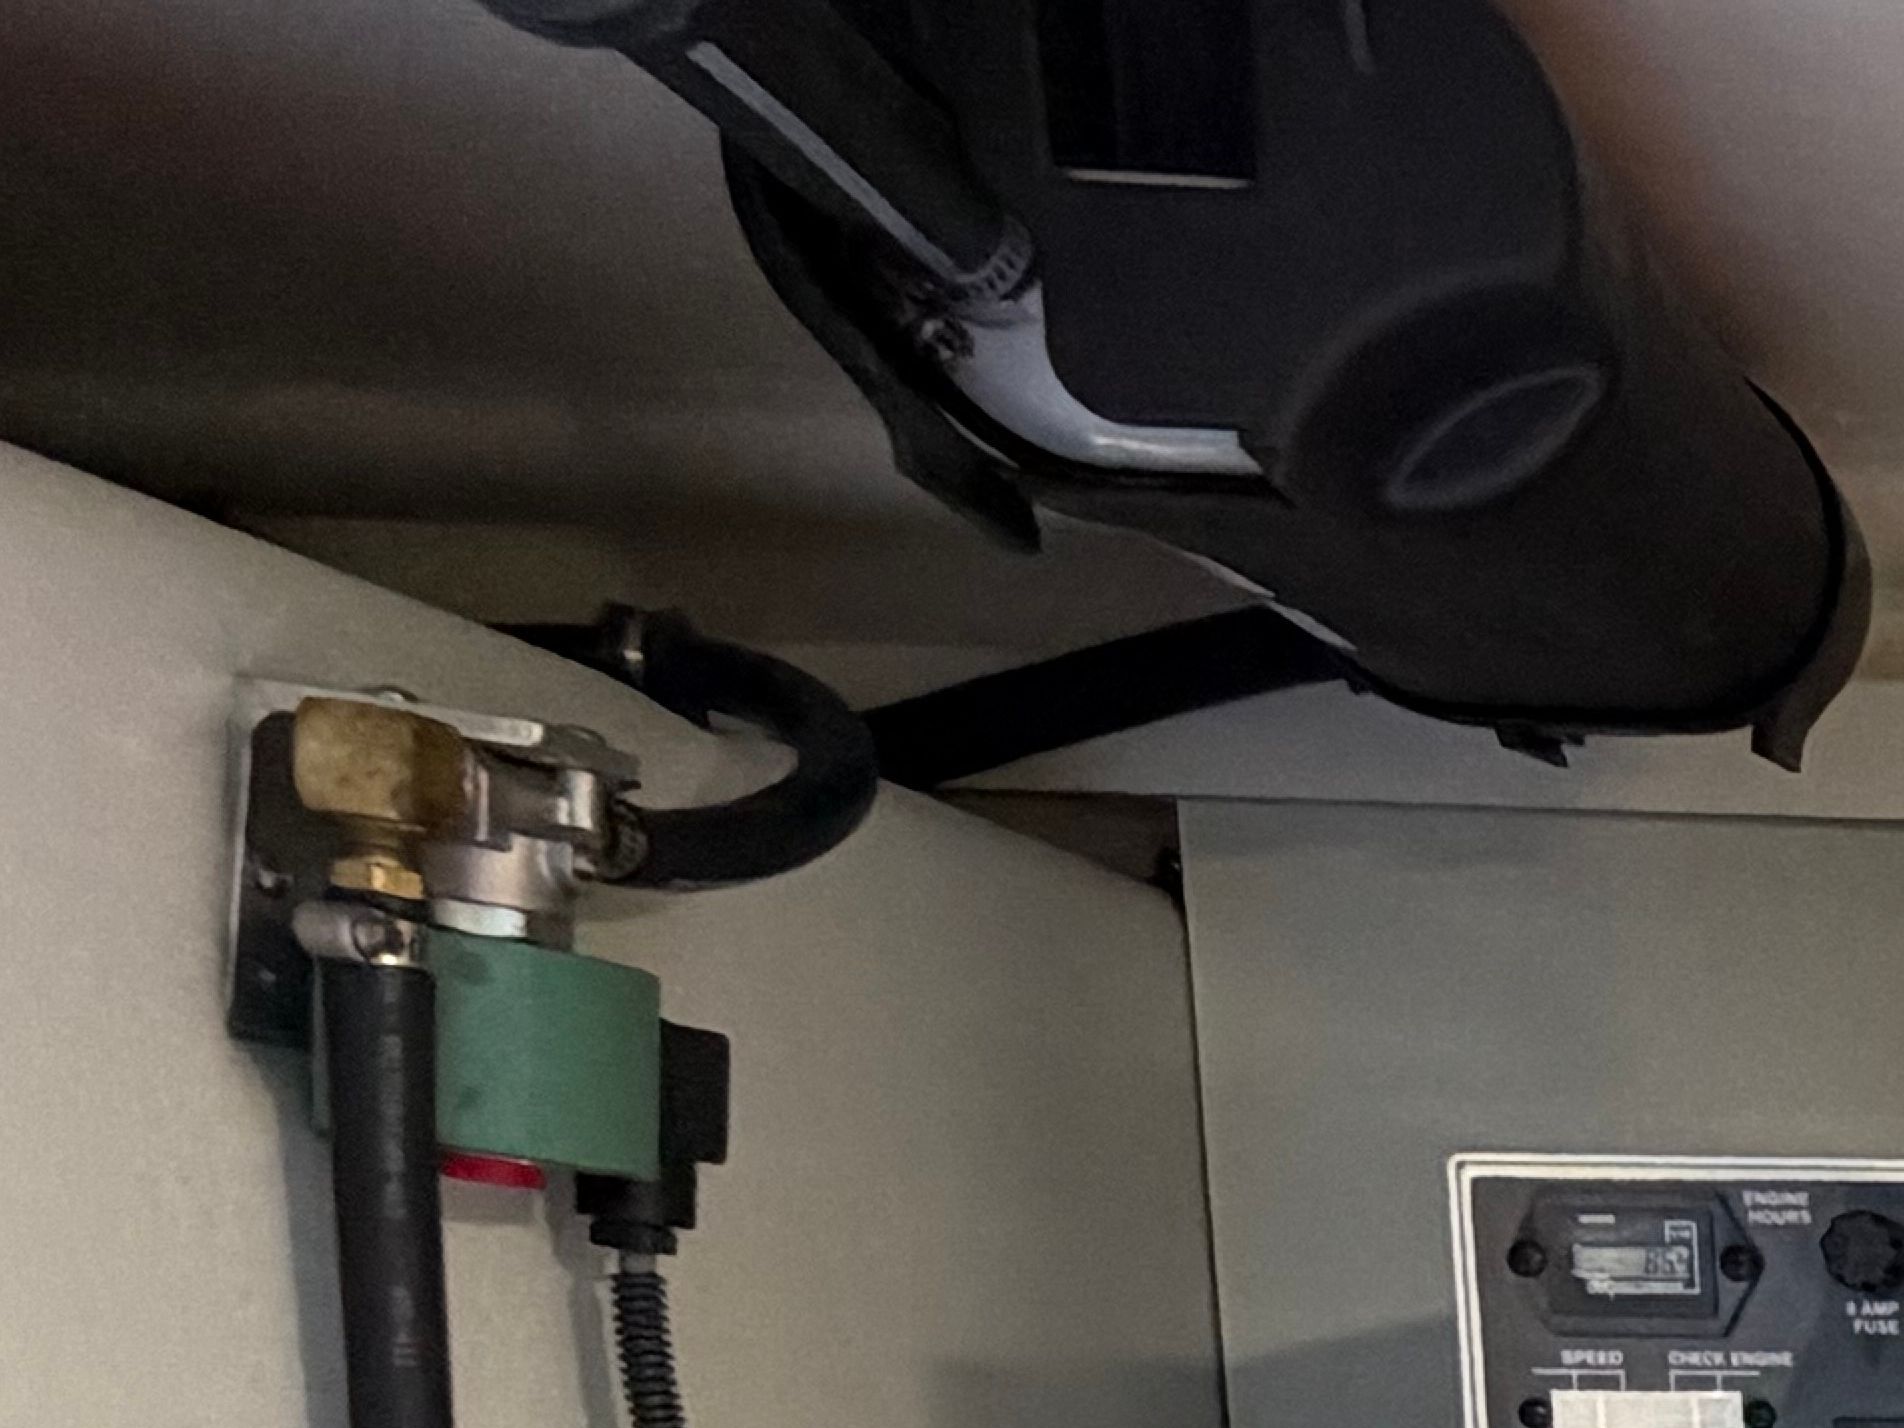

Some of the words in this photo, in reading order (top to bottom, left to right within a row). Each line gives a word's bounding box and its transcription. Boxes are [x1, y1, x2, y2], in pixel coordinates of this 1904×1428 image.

[1743, 1190, 1809, 1207] ENGINE
[1748, 1209, 1812, 1226] HOURS
[1861, 1299, 1900, 1316] AMP
[1854, 1319, 1899, 1335] FUSE
[1561, 1350, 1624, 1365] SPEED
[1668, 1350, 1725, 1366] CHECK
[1730, 1352, 1794, 1368] ENGINE
